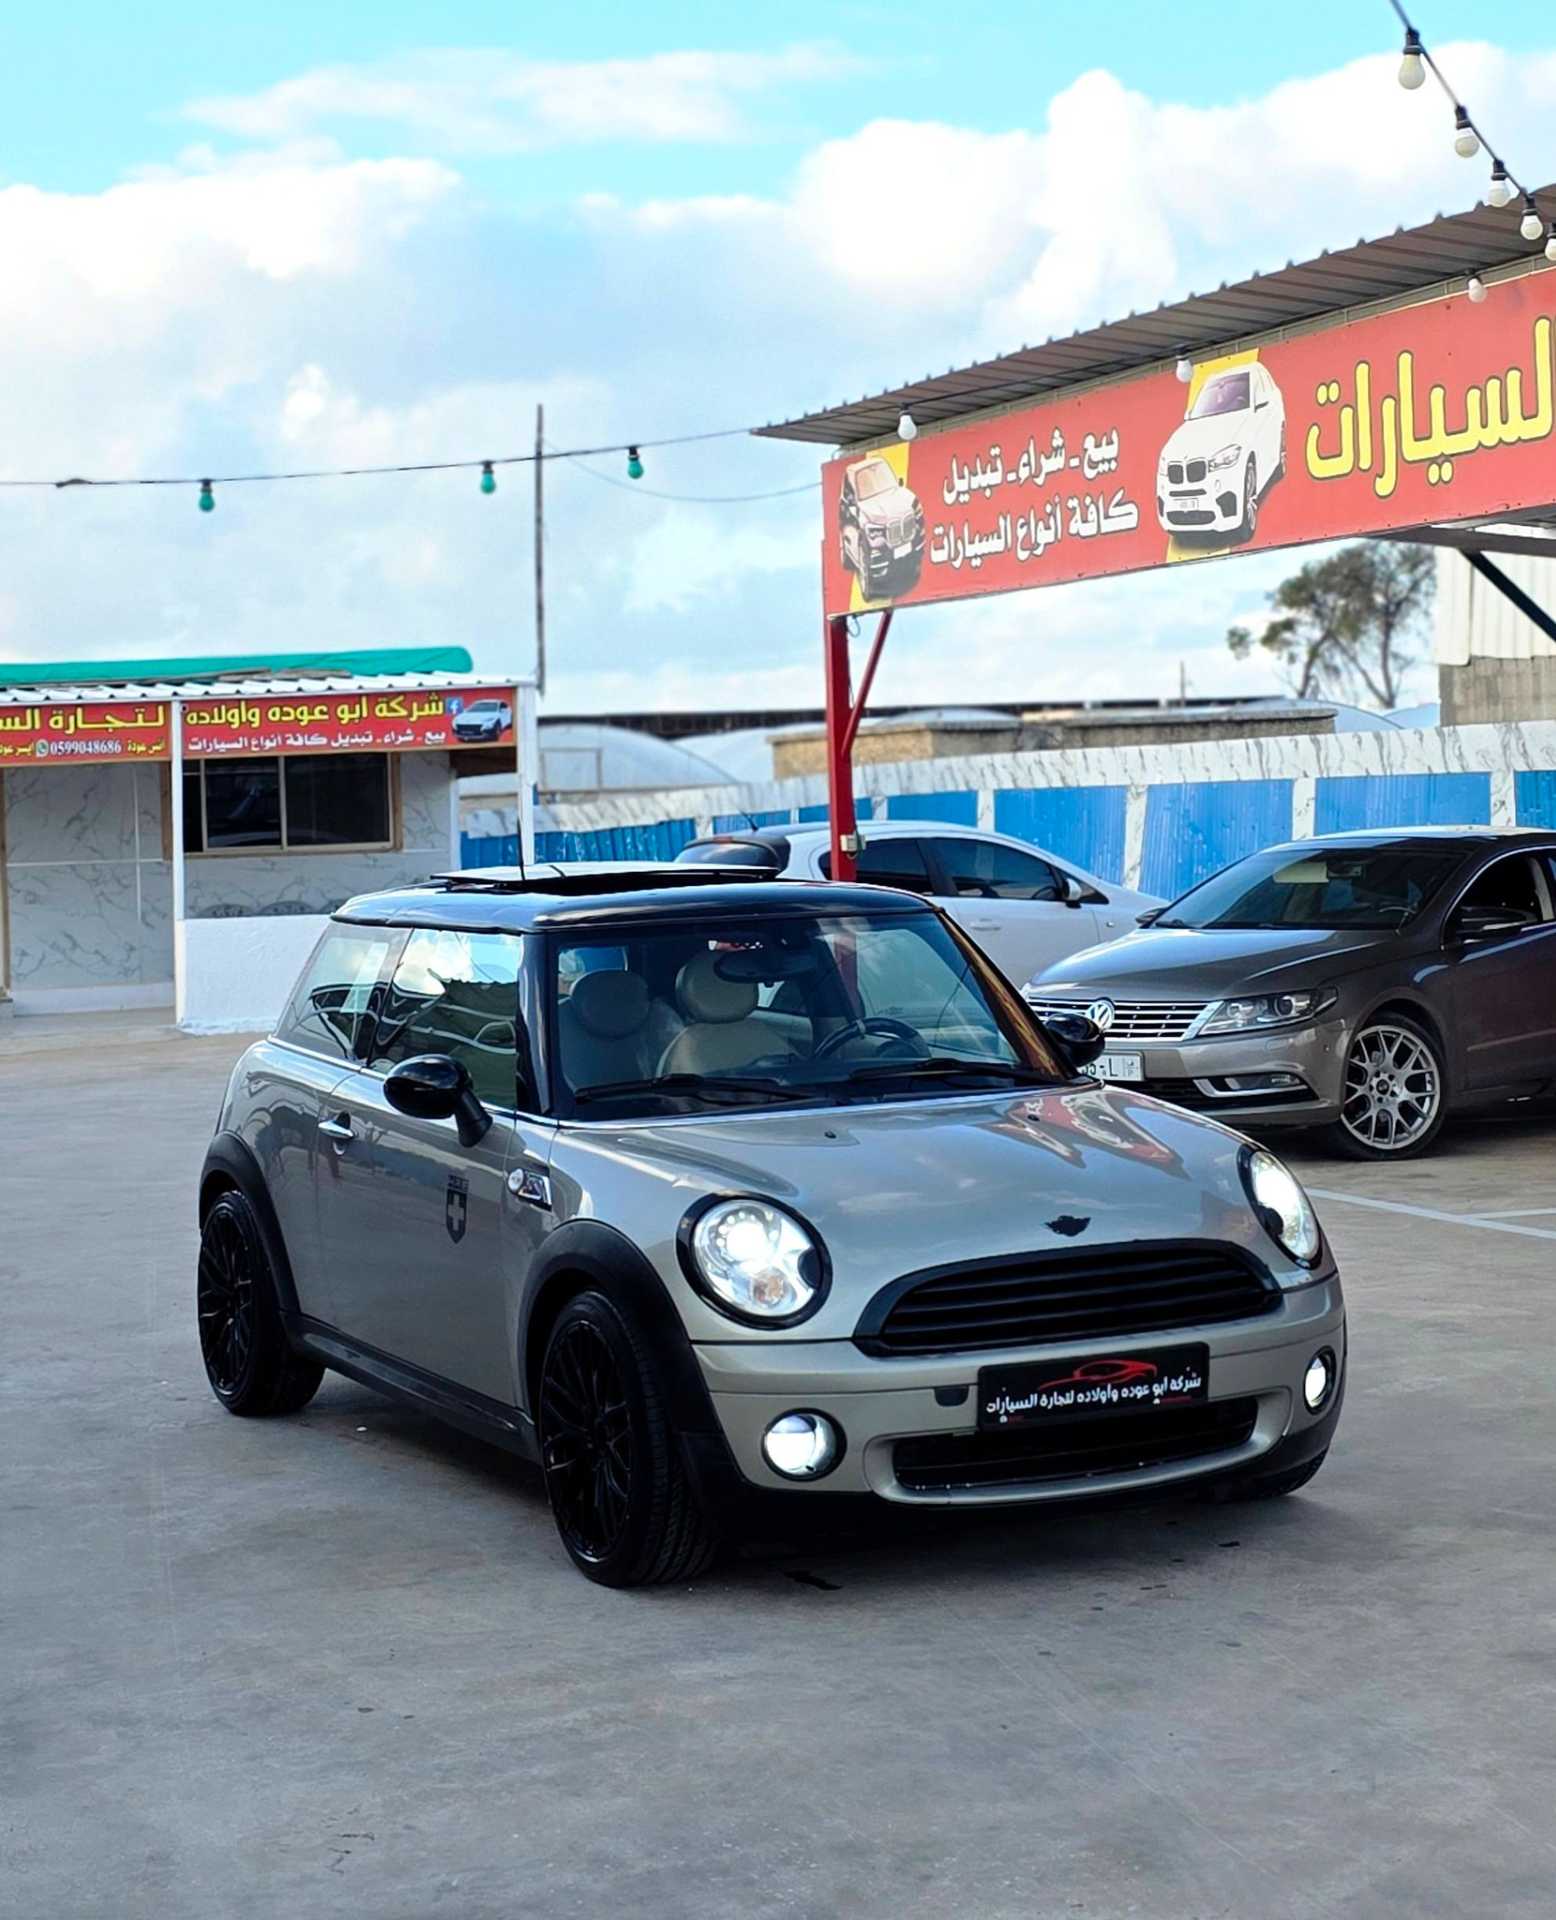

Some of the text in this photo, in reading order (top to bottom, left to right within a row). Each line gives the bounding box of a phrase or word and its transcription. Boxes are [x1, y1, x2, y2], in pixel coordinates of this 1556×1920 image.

[1305, 316, 1556, 498] لسيارات
[943, 444, 1003, 504] تبديل
[1083, 427, 1119, 480] بيع
[929, 487, 1139, 569] كافة أنواع السيارات
[49, 704, 165, 735] لتجارة
[374, 692, 444, 722] شركة
[188, 735, 248, 752] السيارات
[285, 732, 328, 746] كافة
